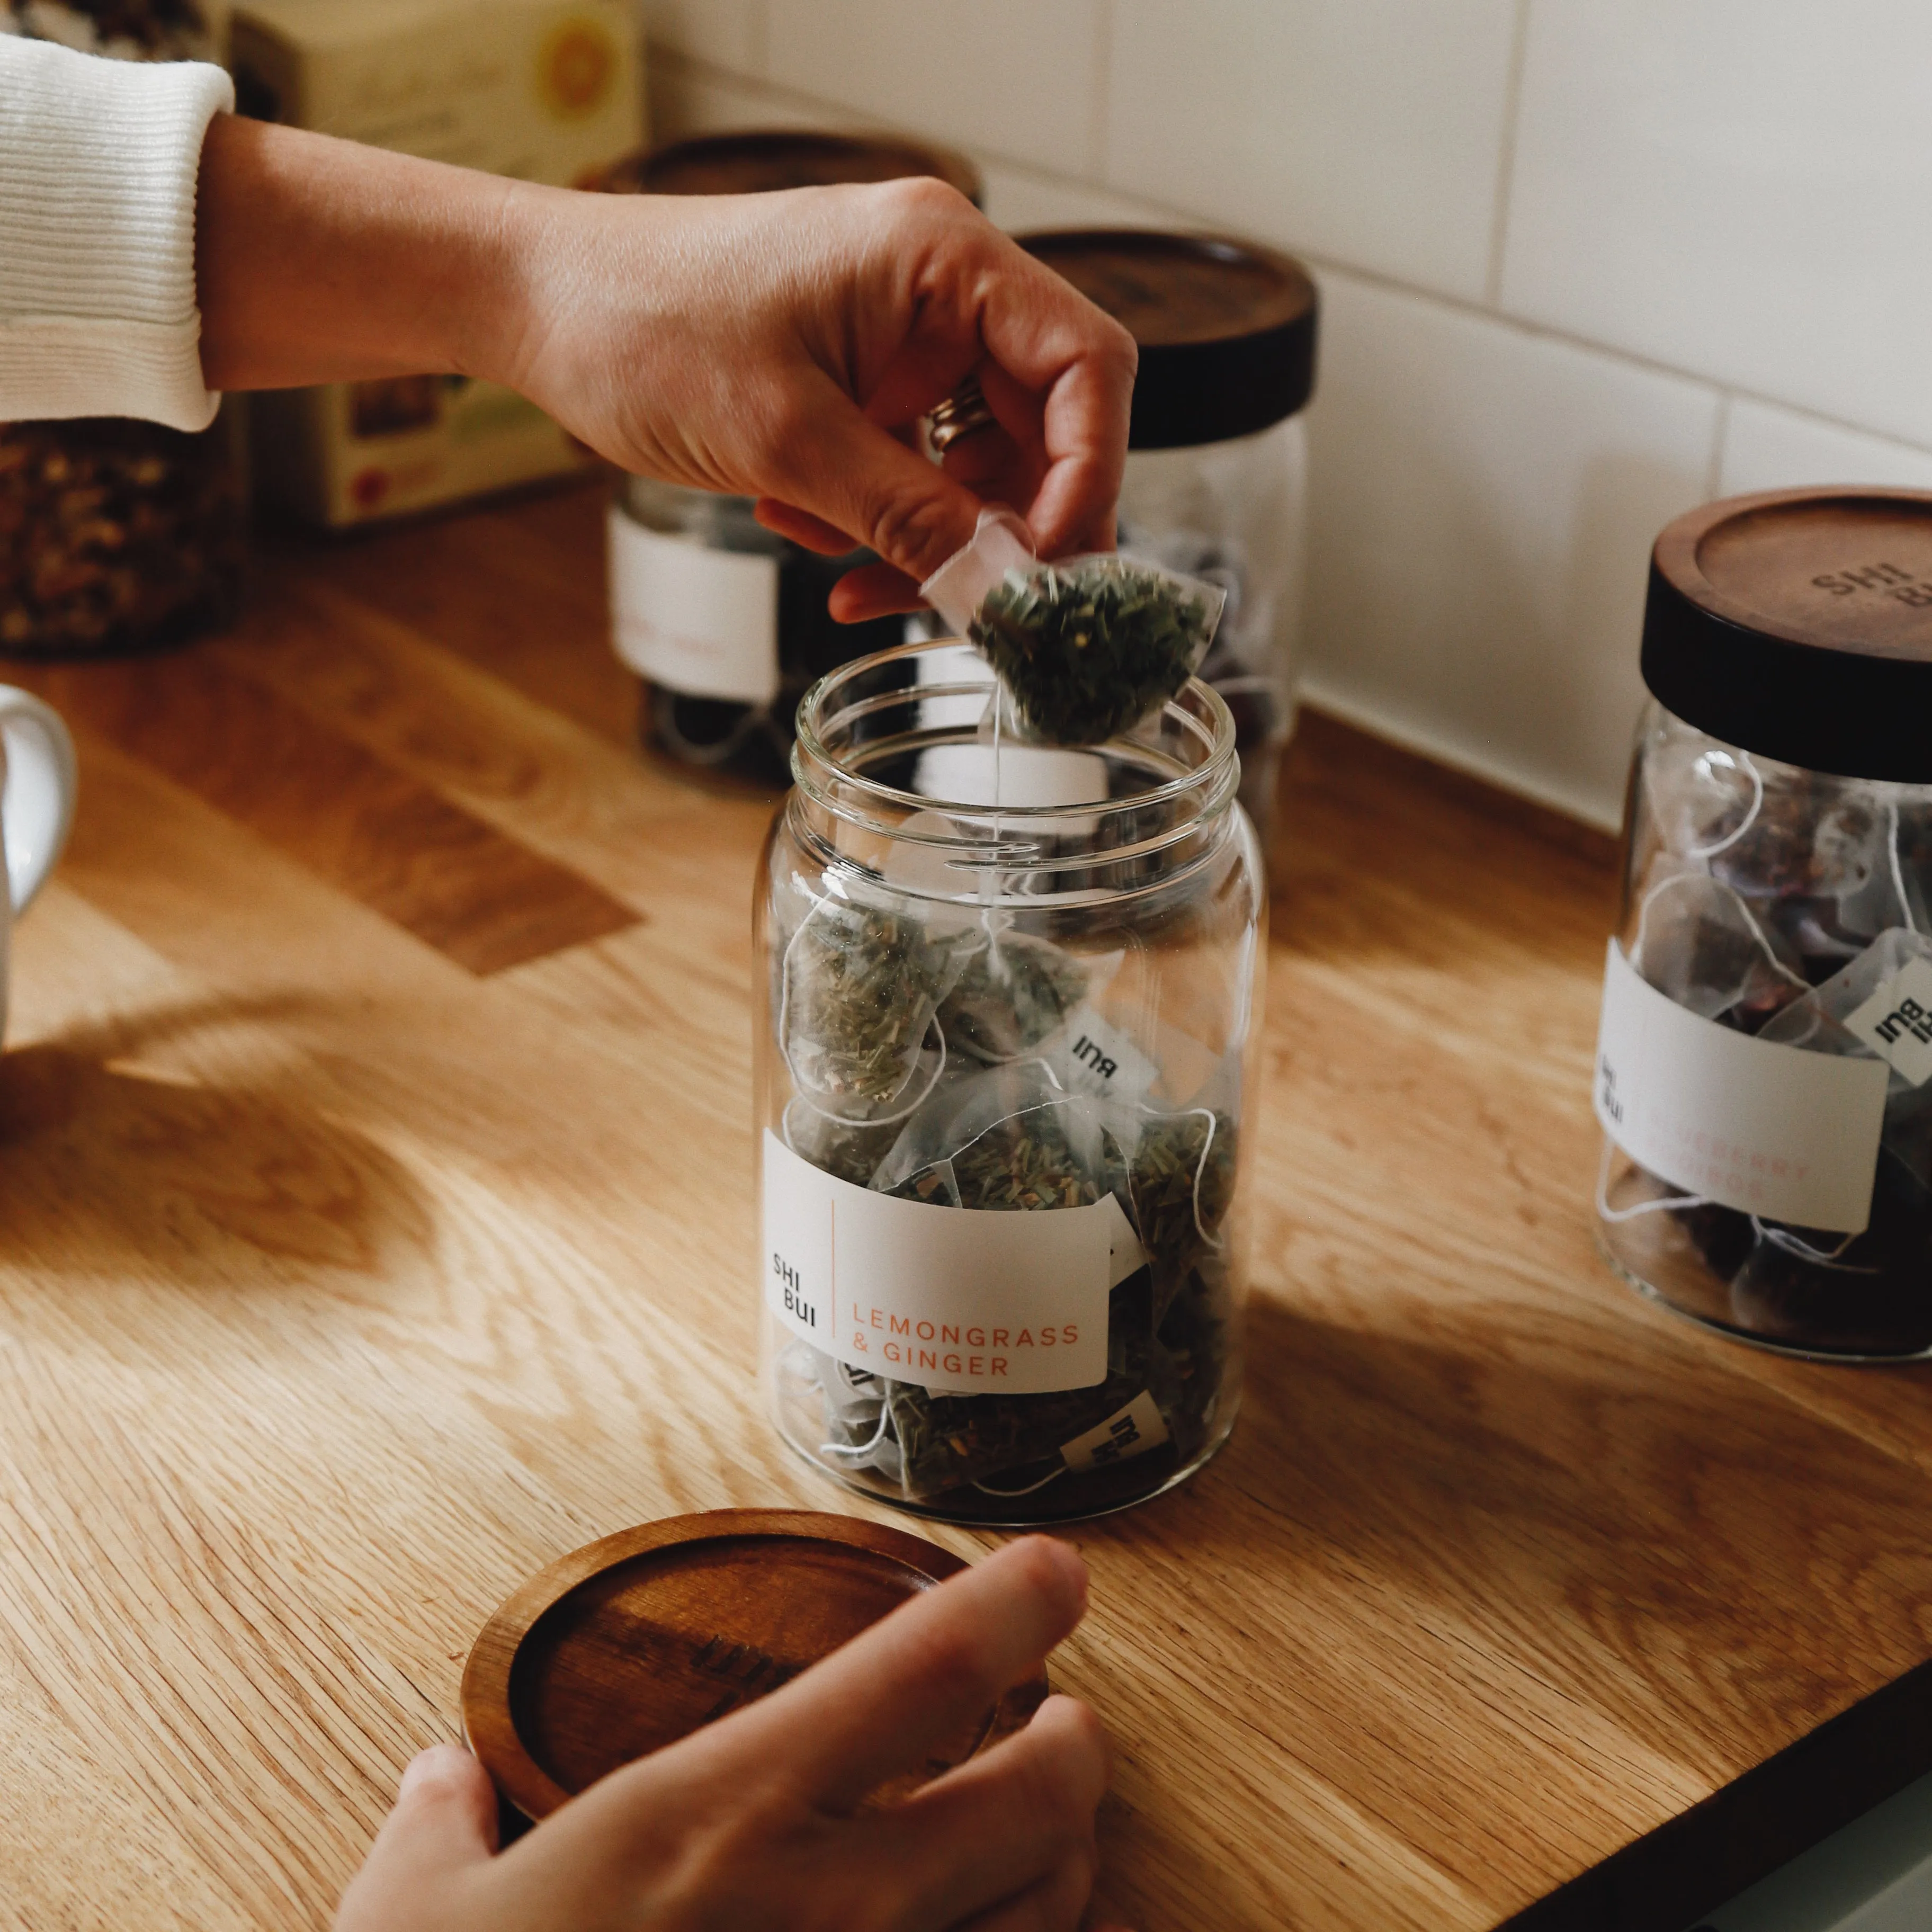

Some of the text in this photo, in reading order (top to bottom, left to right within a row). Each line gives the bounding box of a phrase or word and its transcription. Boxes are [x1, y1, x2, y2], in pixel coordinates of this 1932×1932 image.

[1811, 562, 1914, 595] SHI
[1875, 997, 1923, 1044] BUI
[773, 1253, 800, 1292] SHI
[784, 1288, 816, 1328] BUI
[853, 1303, 1080, 1348] LEMONGRASS
[853, 1331, 869, 1352] &
[884, 1341, 1008, 1377] GINGER
